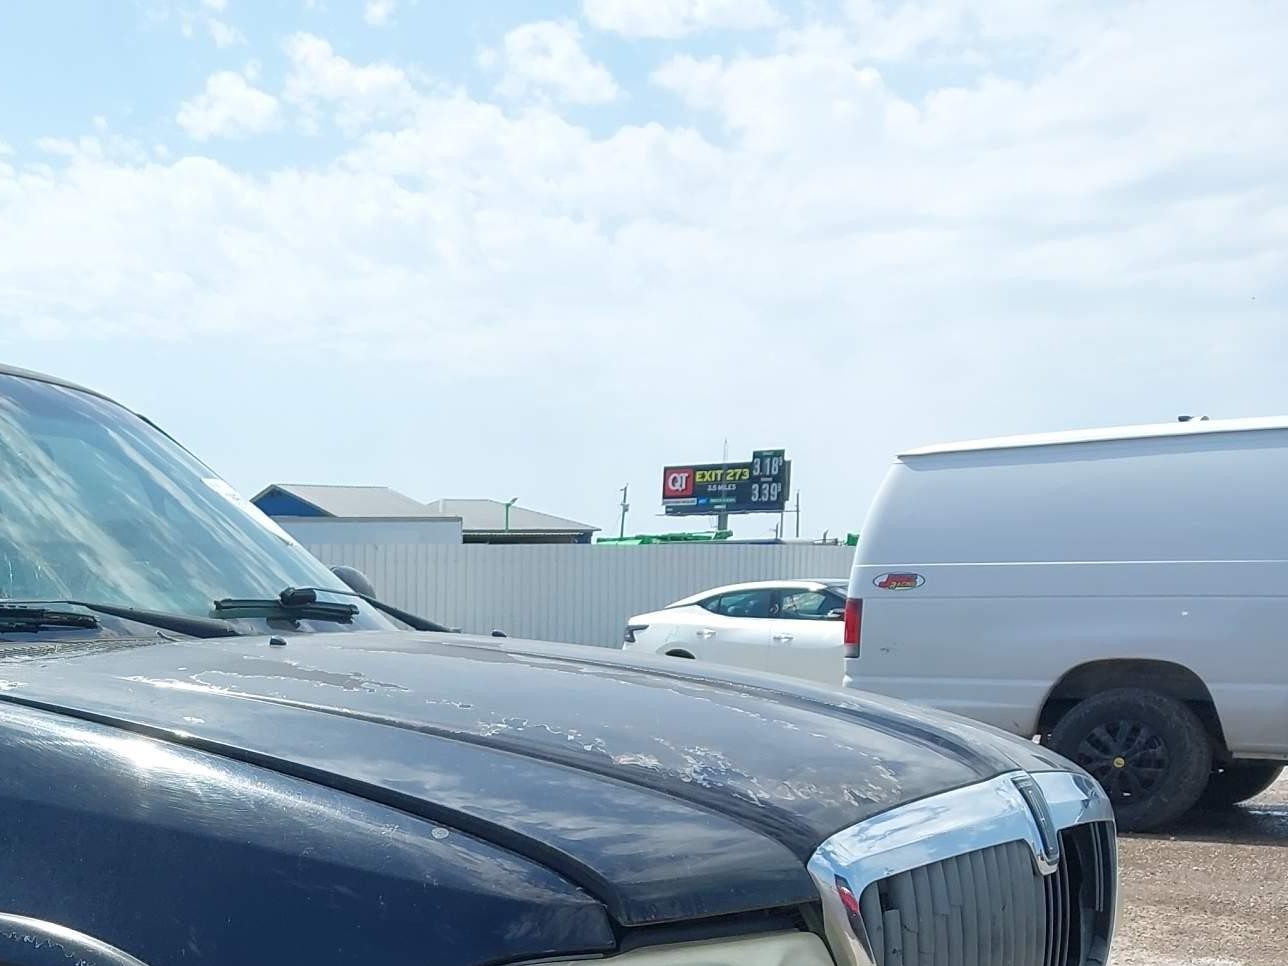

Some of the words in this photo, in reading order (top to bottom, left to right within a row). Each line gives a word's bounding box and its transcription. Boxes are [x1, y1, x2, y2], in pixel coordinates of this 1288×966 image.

[668, 473, 689, 491] QT
[695, 469, 723, 482] EXIT
[726, 468, 750, 481] 273
